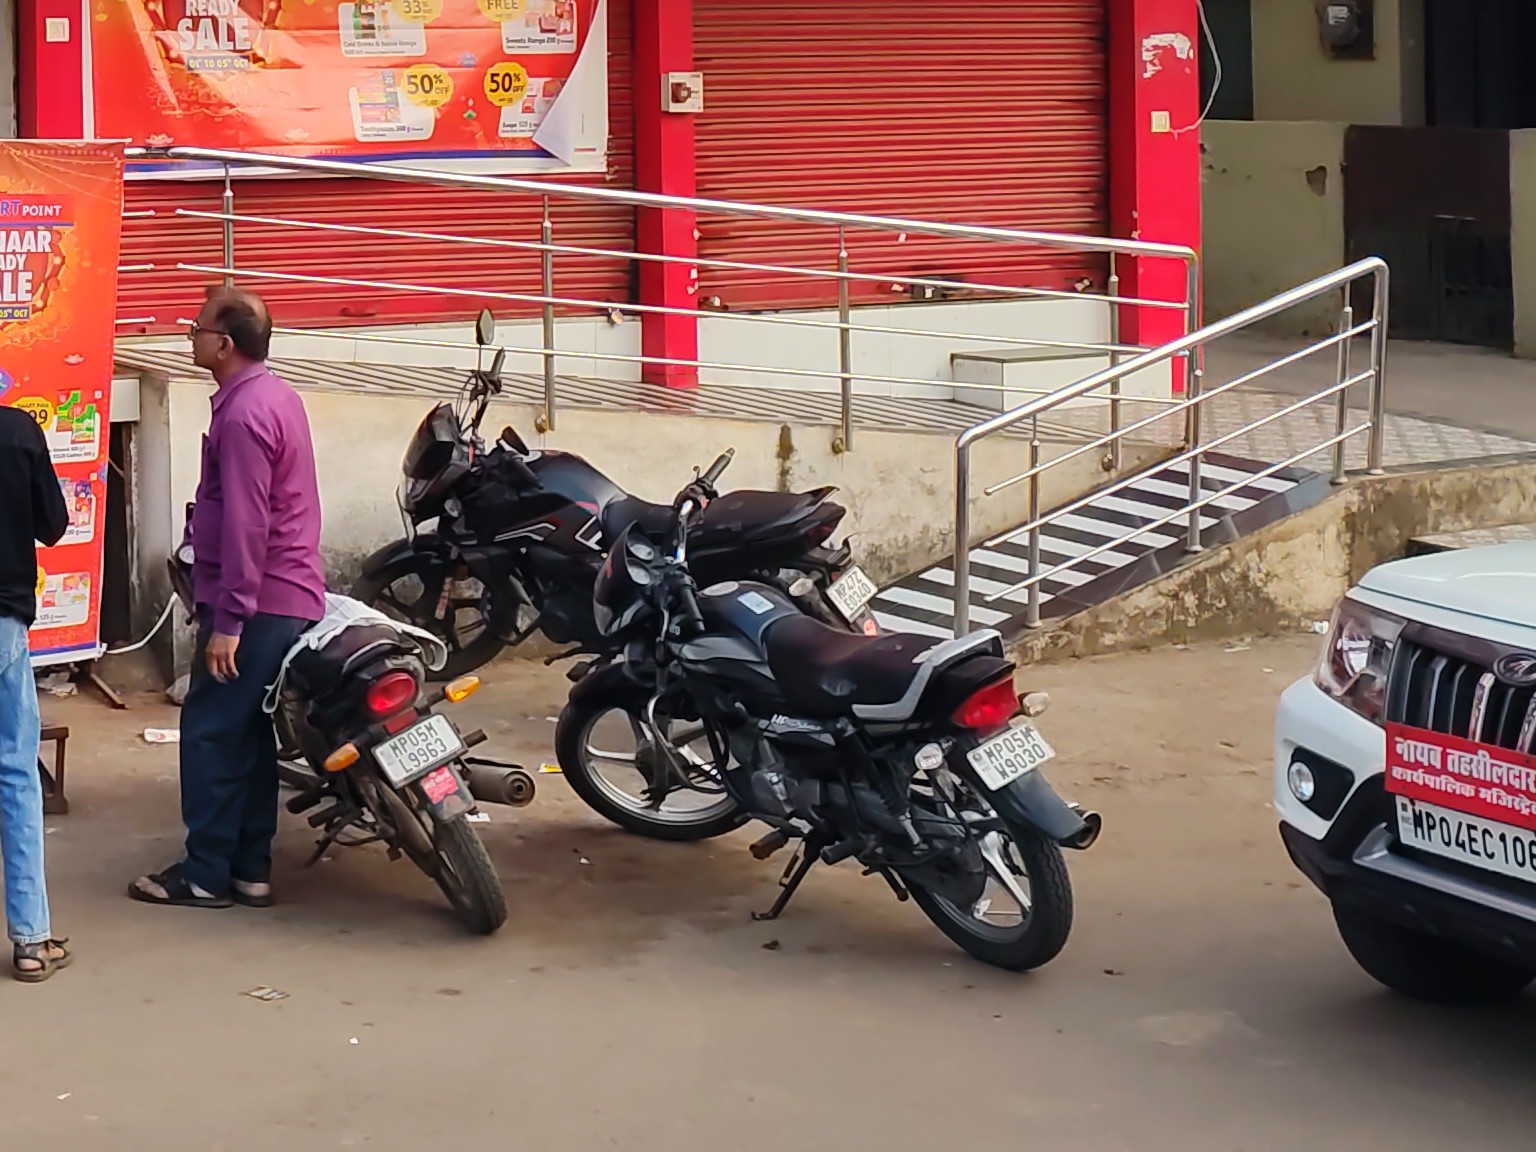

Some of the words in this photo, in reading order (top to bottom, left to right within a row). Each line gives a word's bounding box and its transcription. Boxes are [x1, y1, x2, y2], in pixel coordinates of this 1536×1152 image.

[177, 17, 253, 51] SALE
[21, 205, 63, 217] POINT
[388, 721, 439, 759] MP05M
[398, 737, 448, 774] L9963
[1391, 766, 1477, 798] कार्यपालिक
[1445, 748, 1536, 795] तहसीलदार
